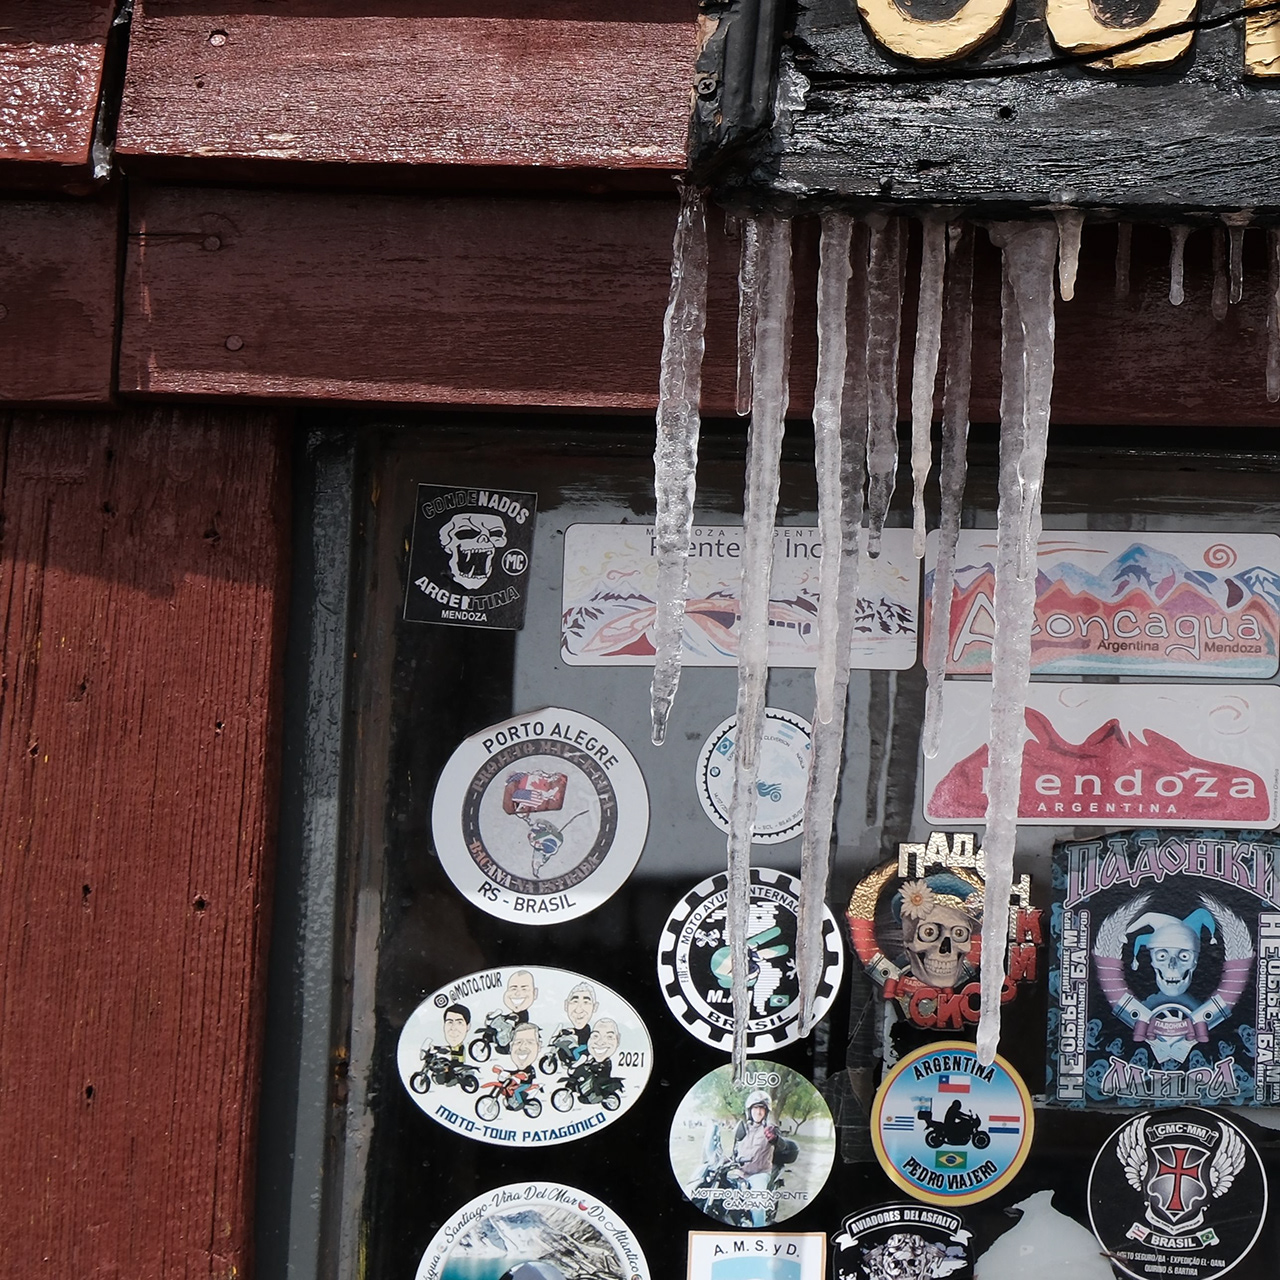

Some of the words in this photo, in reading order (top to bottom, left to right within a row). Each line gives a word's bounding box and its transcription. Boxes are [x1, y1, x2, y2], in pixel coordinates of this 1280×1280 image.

[422, 491, 529, 524] CONDENADOS
[506, 555, 524, 570] MC
[414, 576, 520, 610] ARGENTINA
[441, 610, 487, 621] MENDOZA
[953, 592, 1262, 661] Aoncagua
[1097, 640, 1159, 652] Argentina
[1204, 641, 1262, 653] Mendoza
[482, 722, 544, 753] PORTO
[550, 723, 619, 770] ALEGRE
[1037, 803, 1177, 813] ARGENTINA
[478, 881, 501, 902] RS
[514, 894, 576, 913] BRASIL
[681, 912, 702, 944] MOTO
[450, 972, 502, 1003] @MOTO.TOUR
[618, 1052, 644, 1068] 2021
[913, 1055, 996, 1083] ARGENTINA
[1102, 1057, 1240, 1100] МИРА
[435, 1105, 517, 1142] MOTO-TOUR
[523, 1112, 606, 1142] PATAGÓNICO
[1158, 1124, 1206, 1138] CMC-MM
[902, 1156, 944, 1189] PEDRO
[948, 1160, 997, 1190] VIAJERO
[524, 1185, 547, 1200] Del
[547, 1189, 577, 1205] Mar
[587, 1205, 605, 1222] Do
[690, 1188, 731, 1199] MOTERO
[734, 1190, 808, 1200] INDEPENDIENTE
[723, 1199, 775, 1210] CAMPANA
[851, 1211, 901, 1234] AVIADORES
[904, 1209, 921, 1220] DEL
[920, 1211, 958, 1229] ASFALTO
[713, 1244, 729, 1256] A.
[734, 1241, 749, 1252] M.
[754, 1240, 769, 1251] S.
[774, 1243, 783, 1255] y
[786, 1244, 800, 1257] D.
[1151, 1236, 1196, 1248] BRASIL
